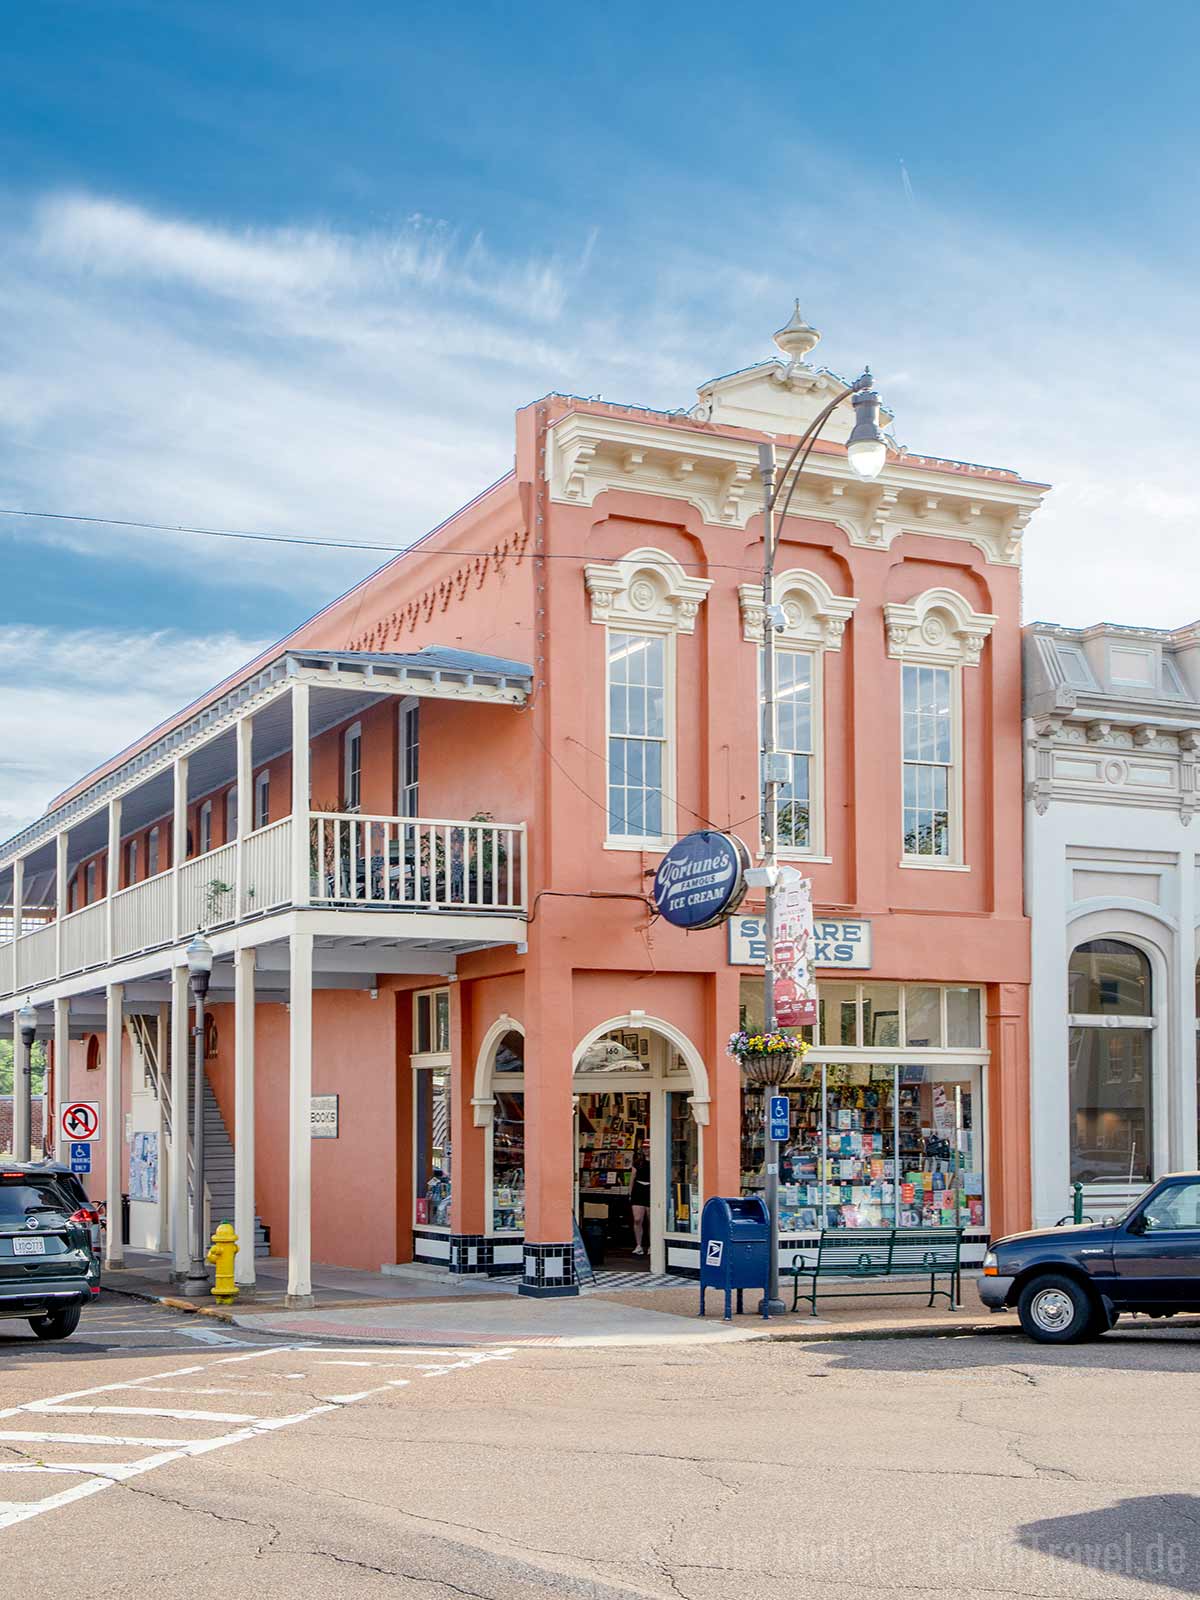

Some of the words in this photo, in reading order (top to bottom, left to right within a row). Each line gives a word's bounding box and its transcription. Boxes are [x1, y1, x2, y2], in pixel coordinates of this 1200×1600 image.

[656, 850, 729, 906] Fortune's
[680, 874, 716, 890] FAMOUS
[669, 896, 685, 911] ICE
[688, 887, 724, 906] CREAM
